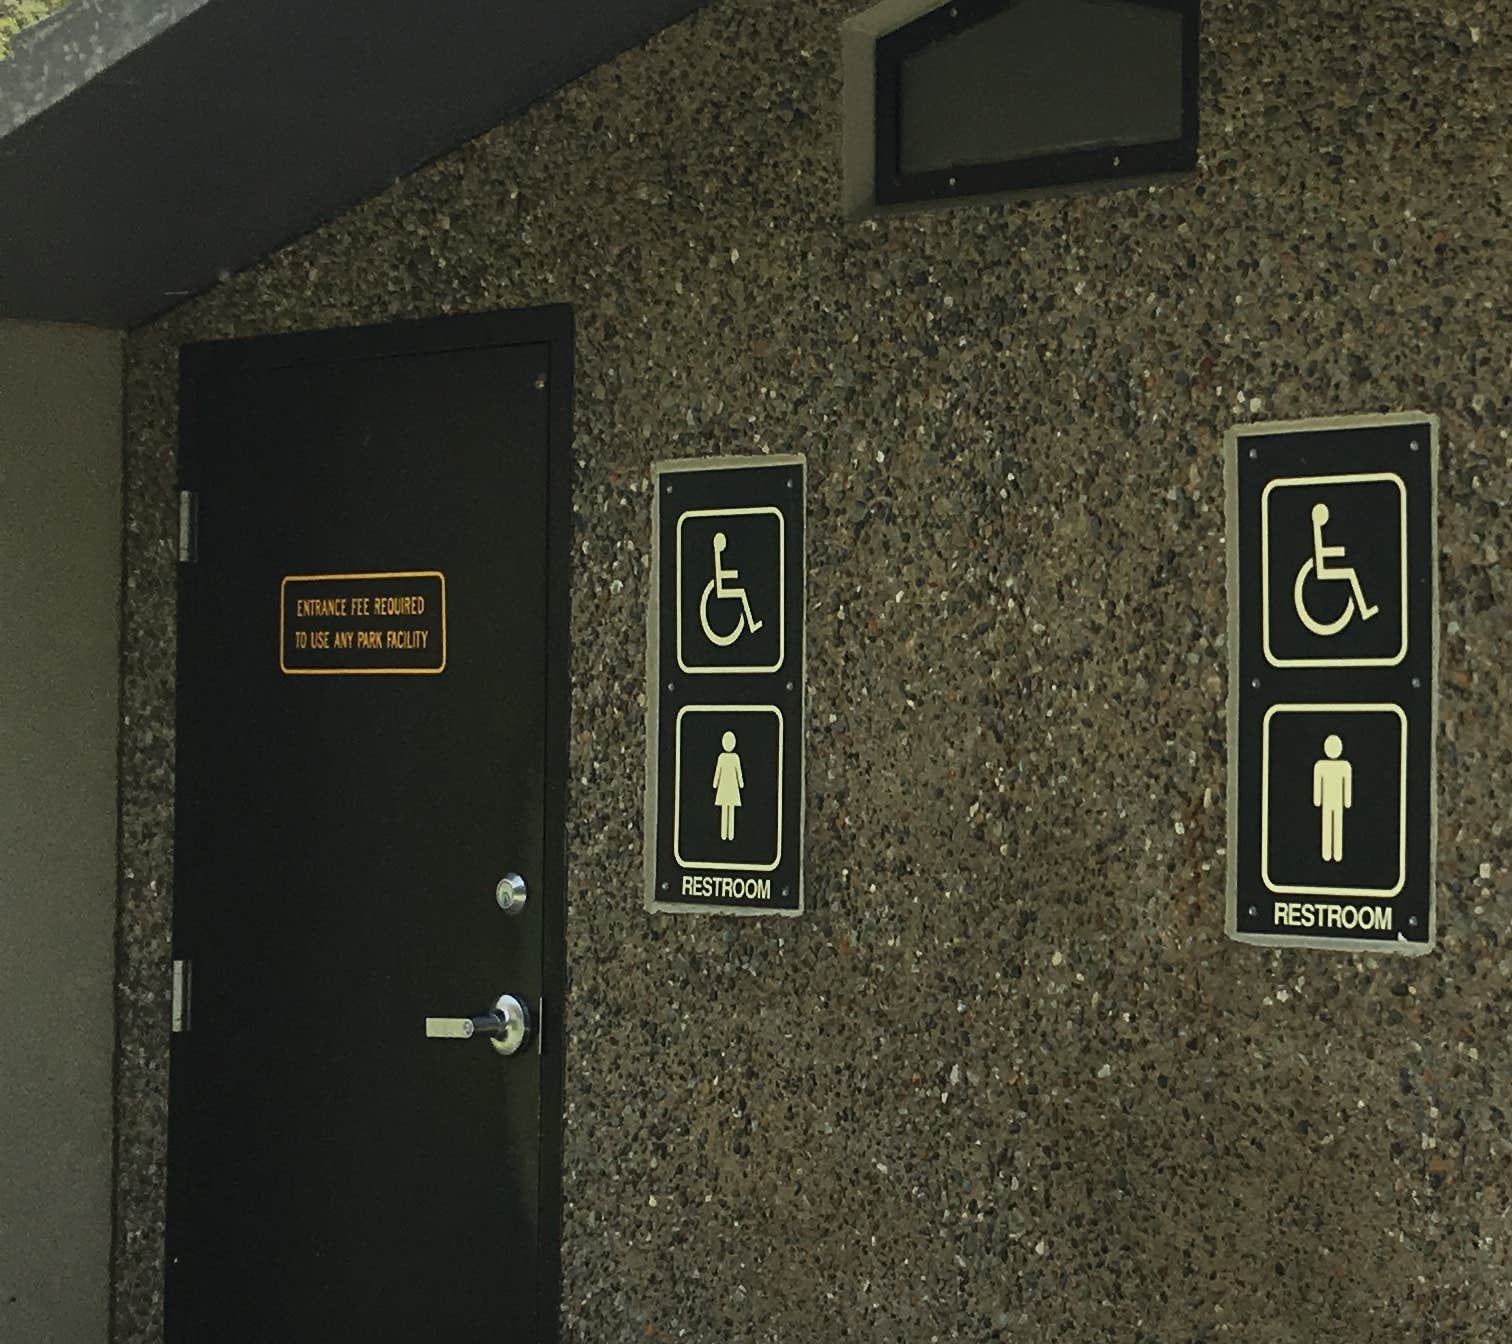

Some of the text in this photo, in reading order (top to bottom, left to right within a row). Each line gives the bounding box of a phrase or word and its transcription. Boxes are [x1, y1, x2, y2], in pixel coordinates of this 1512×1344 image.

[297, 596, 424, 616] ENTRANCE FEE REQUIRED
[296, 631, 428, 648] TO USE ANY PARK FACILITY
[682, 876, 770, 899] RESTROOM
[1275, 902, 1392, 930] RESTROOM
